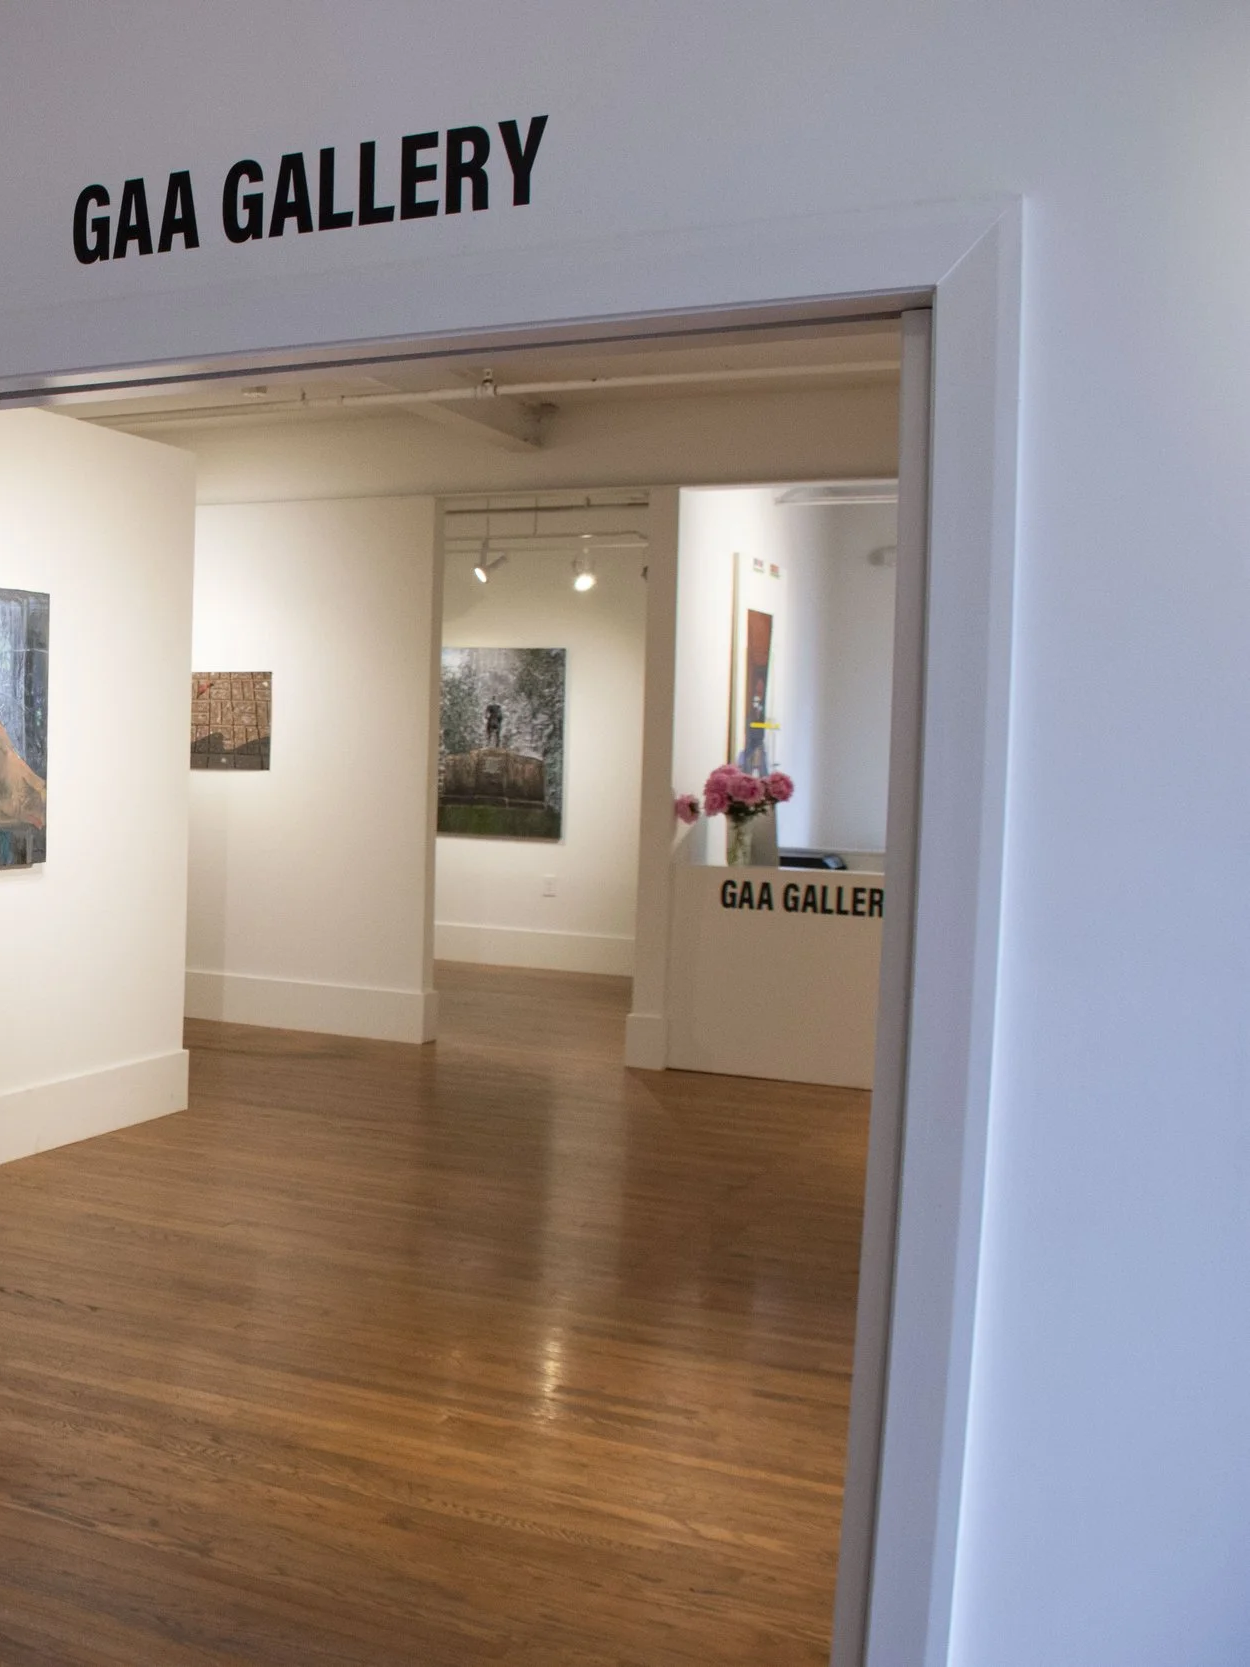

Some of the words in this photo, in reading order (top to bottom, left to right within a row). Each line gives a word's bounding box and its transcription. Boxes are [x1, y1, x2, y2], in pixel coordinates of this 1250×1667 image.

[72, 169, 200, 265] GAA
[222, 114, 549, 244] GALLERY
[720, 879, 774, 912] GAA
[782, 882, 884, 919] GALLER
